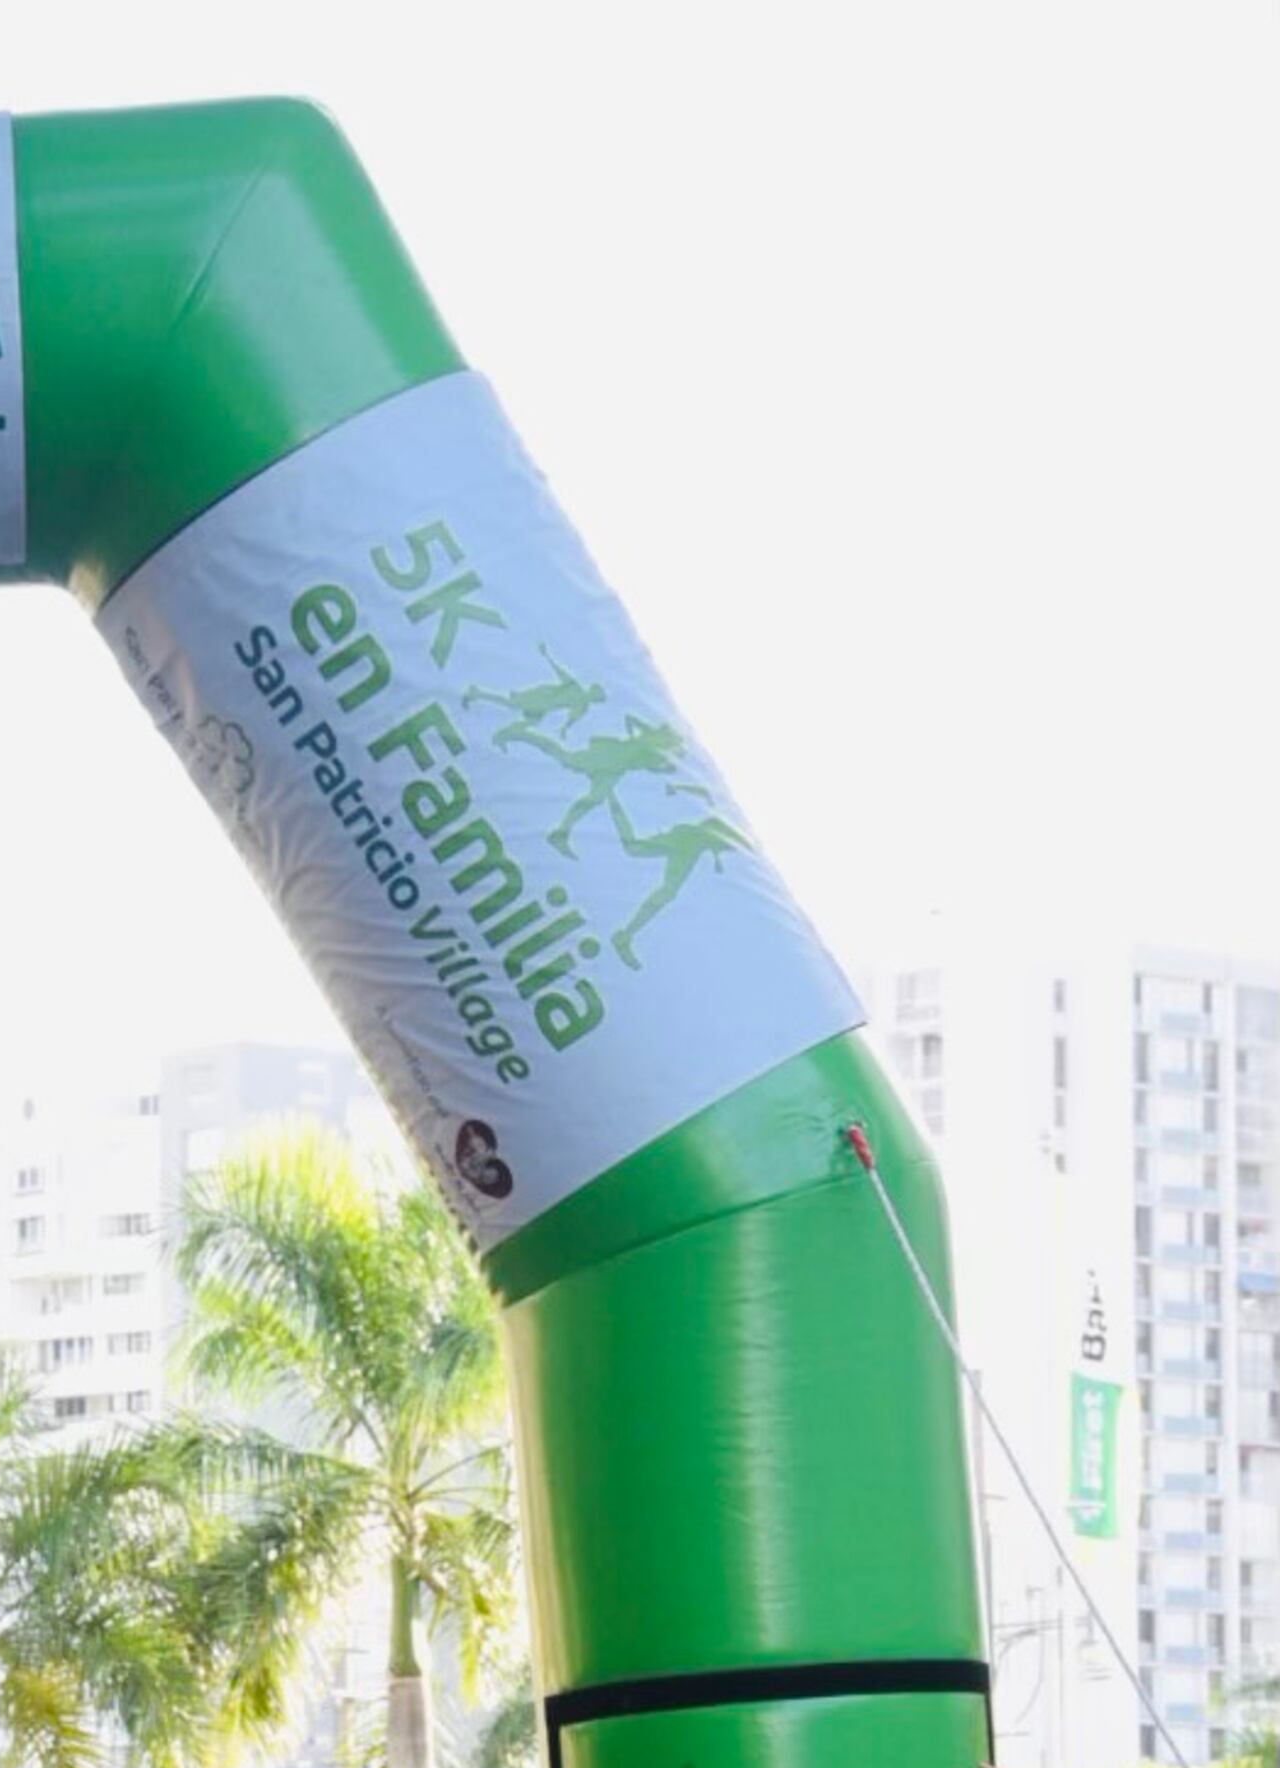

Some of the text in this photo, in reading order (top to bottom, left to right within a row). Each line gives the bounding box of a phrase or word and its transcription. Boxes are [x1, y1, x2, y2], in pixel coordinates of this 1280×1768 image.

[290, 583, 391, 714] en
[366, 701, 605, 1053] Familia
[370, 519, 508, 669] 5K
[233, 625, 304, 727] San
[293, 719, 420, 912] Patricio
[407, 903, 531, 1086] Village
